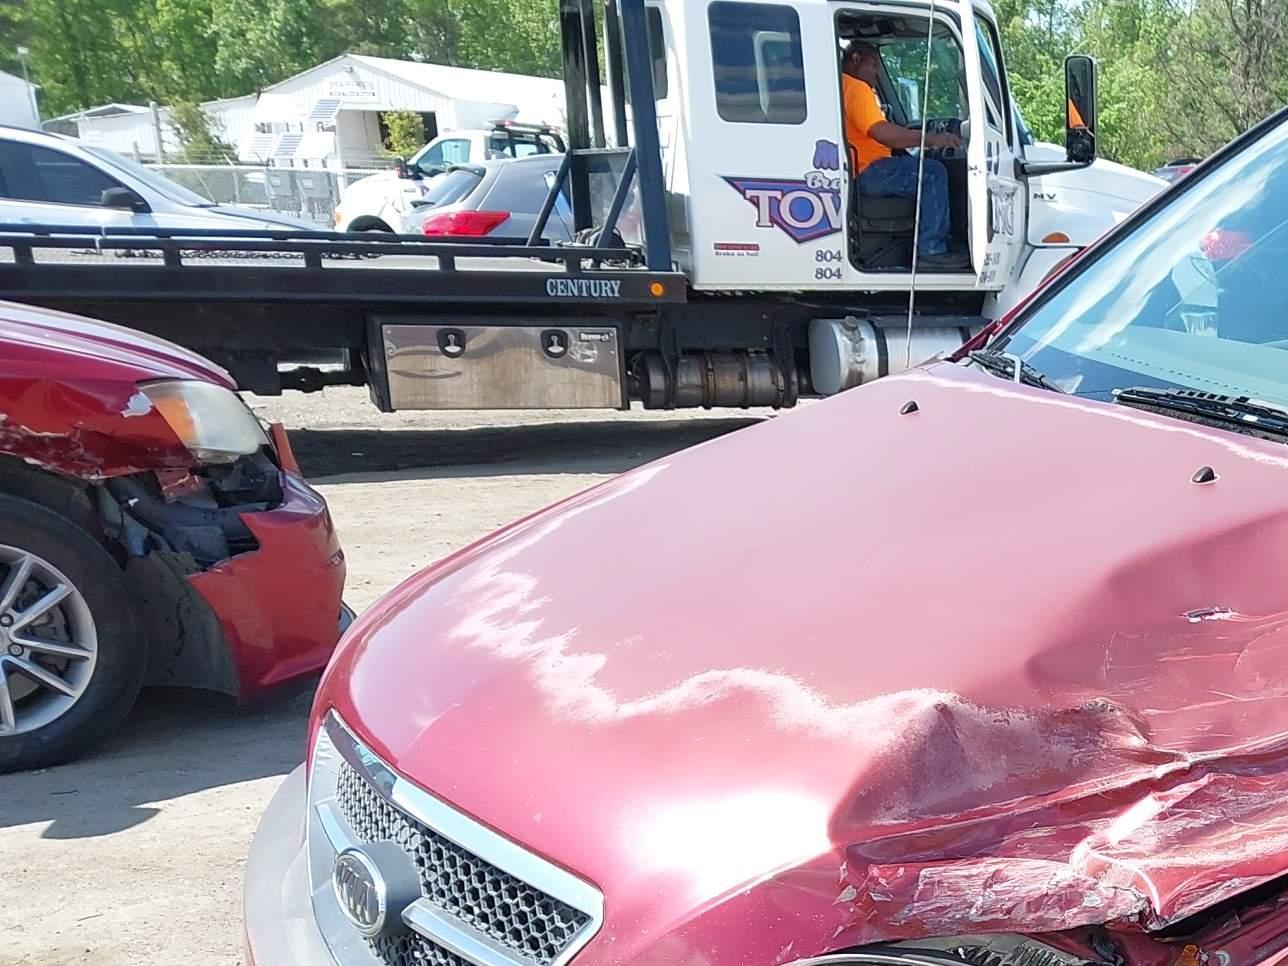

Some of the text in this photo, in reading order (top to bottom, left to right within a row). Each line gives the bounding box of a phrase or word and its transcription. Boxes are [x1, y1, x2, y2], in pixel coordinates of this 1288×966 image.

[815, 250, 842, 262] 804
[815, 268, 842, 280] 804
[546, 278, 621, 297] CENTURY
